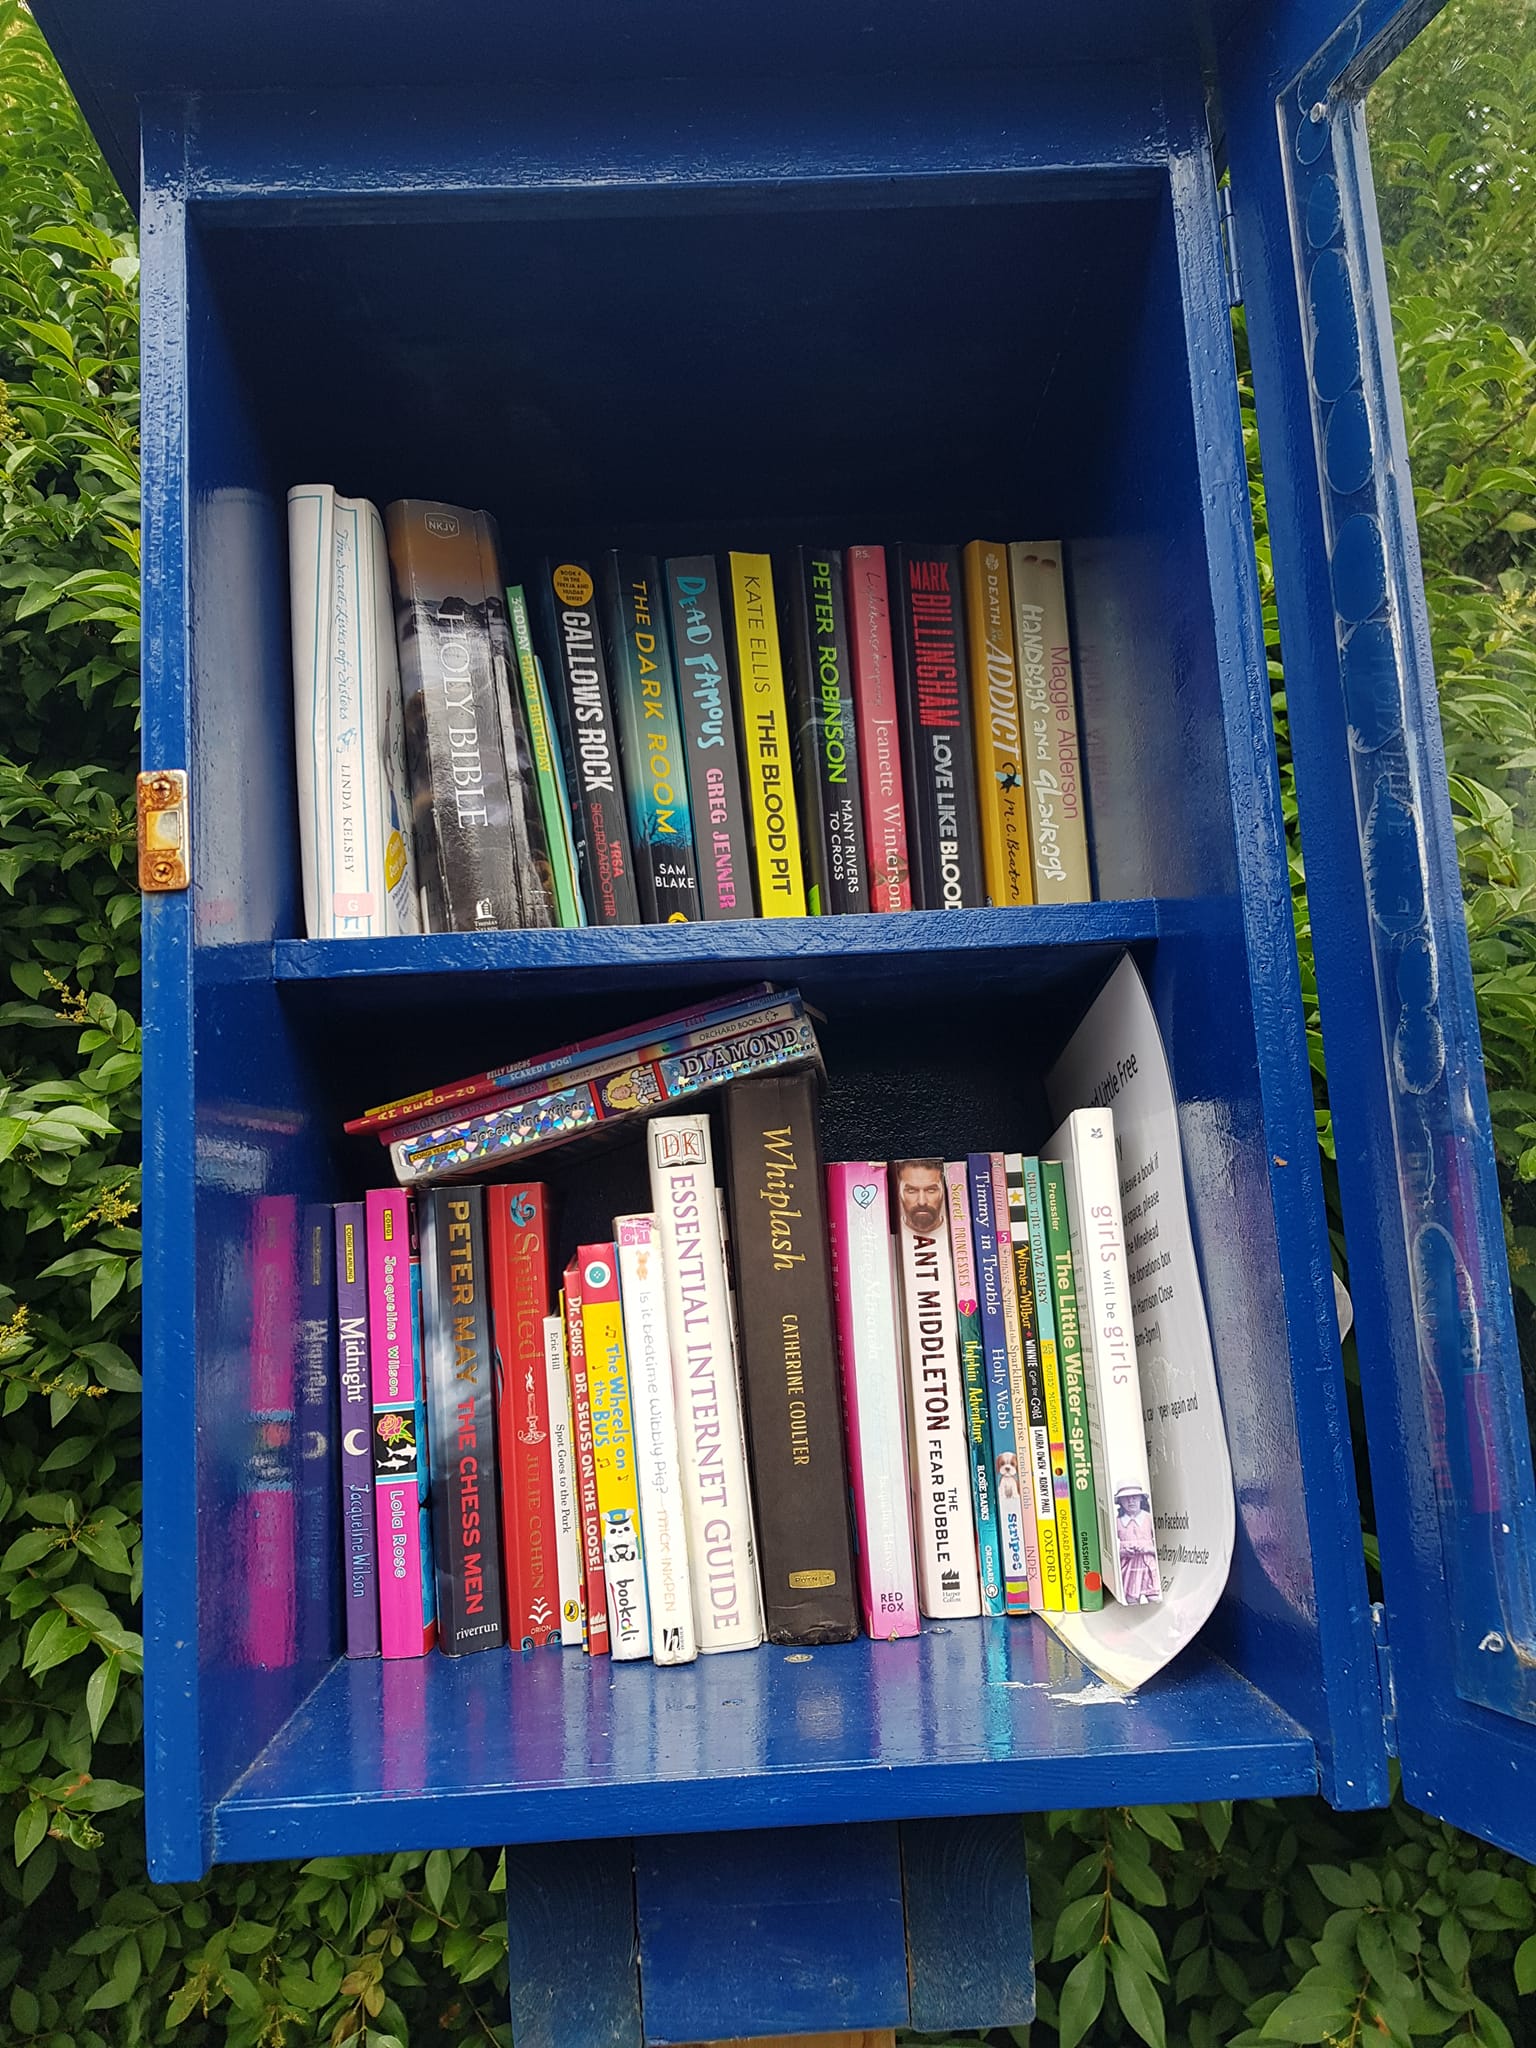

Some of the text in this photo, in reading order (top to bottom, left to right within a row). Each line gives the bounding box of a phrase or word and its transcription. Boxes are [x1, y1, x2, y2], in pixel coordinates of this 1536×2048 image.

[428, 520, 456, 533] NKJV
[743, 575, 771, 694] KATE ELLIS
[987, 574, 1001, 626] DEATH
[811, 560, 849, 784] PETER ROBINSON
[908, 559, 961, 728] MARK BILLINGHAM
[437, 608, 489, 830] HOLY BIBLE
[521, 655, 551, 773] HAPPY BIRTHDAY
[562, 610, 615, 793] GALLOWS ROCK
[632, 580, 678, 834] THE DARK ROOM
[985, 639, 1021, 762] ADDICT
[1049, 646, 1079, 820] Maggie Alderson
[341, 765, 355, 873] LINDA KELSEY
[756, 709, 792, 896] THE BLOOD PIT
[872, 717, 903, 909] Jeanette Winterson
[932, 734, 958, 838] LOVE LIKE
[609, 839, 625, 879] YRSA
[659, 863, 687, 876] SAM
[705, 767, 737, 910] GREG JENNER
[829, 811, 845, 881] TO CROSS
[841, 799, 860, 894] MANY RIVERS
[654, 876, 695, 889] BLAKE
[509, 1055, 574, 1082] SCAREDY DOG!
[680, 1025, 801, 1079] DIAMOND
[698, 1015, 764, 1042] ORCHARD BOOKS
[1116, 1053, 1138, 1088] Free
[401, 1084, 477, 1116] READING
[471, 1113, 541, 1143] Jacqueline
[544, 1099, 588, 1121] Wilson
[411, 1140, 464, 1161] CORGI YEARLING
[661, 1132, 700, 1158] DK
[384, 1211, 393, 1238] CORGI
[759, 1125, 807, 1272] Whiplash
[950, 1182, 971, 1288] Secret PRINCESSES
[1000, 1232, 1008, 1243] 5
[1025, 1171, 1049, 1306] CHLOE THE TOPAZ FAIRY
[1047, 1182, 1060, 1232] Preussler
[974, 1170, 1000, 1315] Timmy in Trouble
[383, 1255, 400, 1397] Jacqueline Wilson
[447, 1200, 478, 1385] PETER MAY
[568, 1295, 584, 1357] Dr. Seuss
[1014, 1242, 1034, 1330] Winnie Wilbur
[1090, 1204, 1132, 1386] girls will be girls
[1157, 1285, 1174, 1304] Close
[339, 1317, 367, 1404] Midnight
[549, 1331, 561, 1371] Eric Hill
[912, 1234, 951, 1432] ANT MIDDLETON
[1055, 1249, 1092, 1491] The Little Water-sprite
[593, 1380, 608, 1406] the
[605, 1343, 631, 1470] The Wheels on
[669, 1172, 741, 1630] ESSENTIAL INTERNET GUIDE
[781, 1313, 811, 1466] CATHERINE COULTER
[990, 1348, 1010, 1430] Holly Webb
[1007, 1344, 1025, 1442] Sparkling Surprise
[1024, 1339, 1043, 1422] WINNIE Gold
[1186, 1391, 1199, 1412] and
[457, 1396, 485, 1616] THE CHESS MEN
[554, 1423, 573, 1534] Spot Goes to the Park
[574, 1372, 605, 1573] DR. SEUSS ON THE LOOSE!
[928, 1439, 952, 1563] FEAR BUBBLE
[947, 1487, 960, 1512] THE
[1033, 1429, 1052, 1515] LAURA OWEN KORKY PAUL
[346, 1483, 373, 1598] Jacqueline Wilson
[389, 1490, 408, 1579] Lola Rose
[526, 1454, 545, 1590] JULIE COHEN
[1025, 1544, 1038, 1582] INDEX
[1043, 1528, 1058, 1583] OXFORD
[1059, 1508, 1073, 1581] ORCHARD BOOKS
[1163, 1510, 1190, 1531] Facebook
[661, 1558, 676, 1613] INKPEN
[880, 1591, 904, 1604] RED
[984, 1544, 994, 1584] ORCHARD
[456, 1621, 500, 1641] riverrun
[530, 1623, 553, 1635] ORION
[615, 1577, 640, 1643] bookoli
[880, 1602, 905, 1614] FOX
